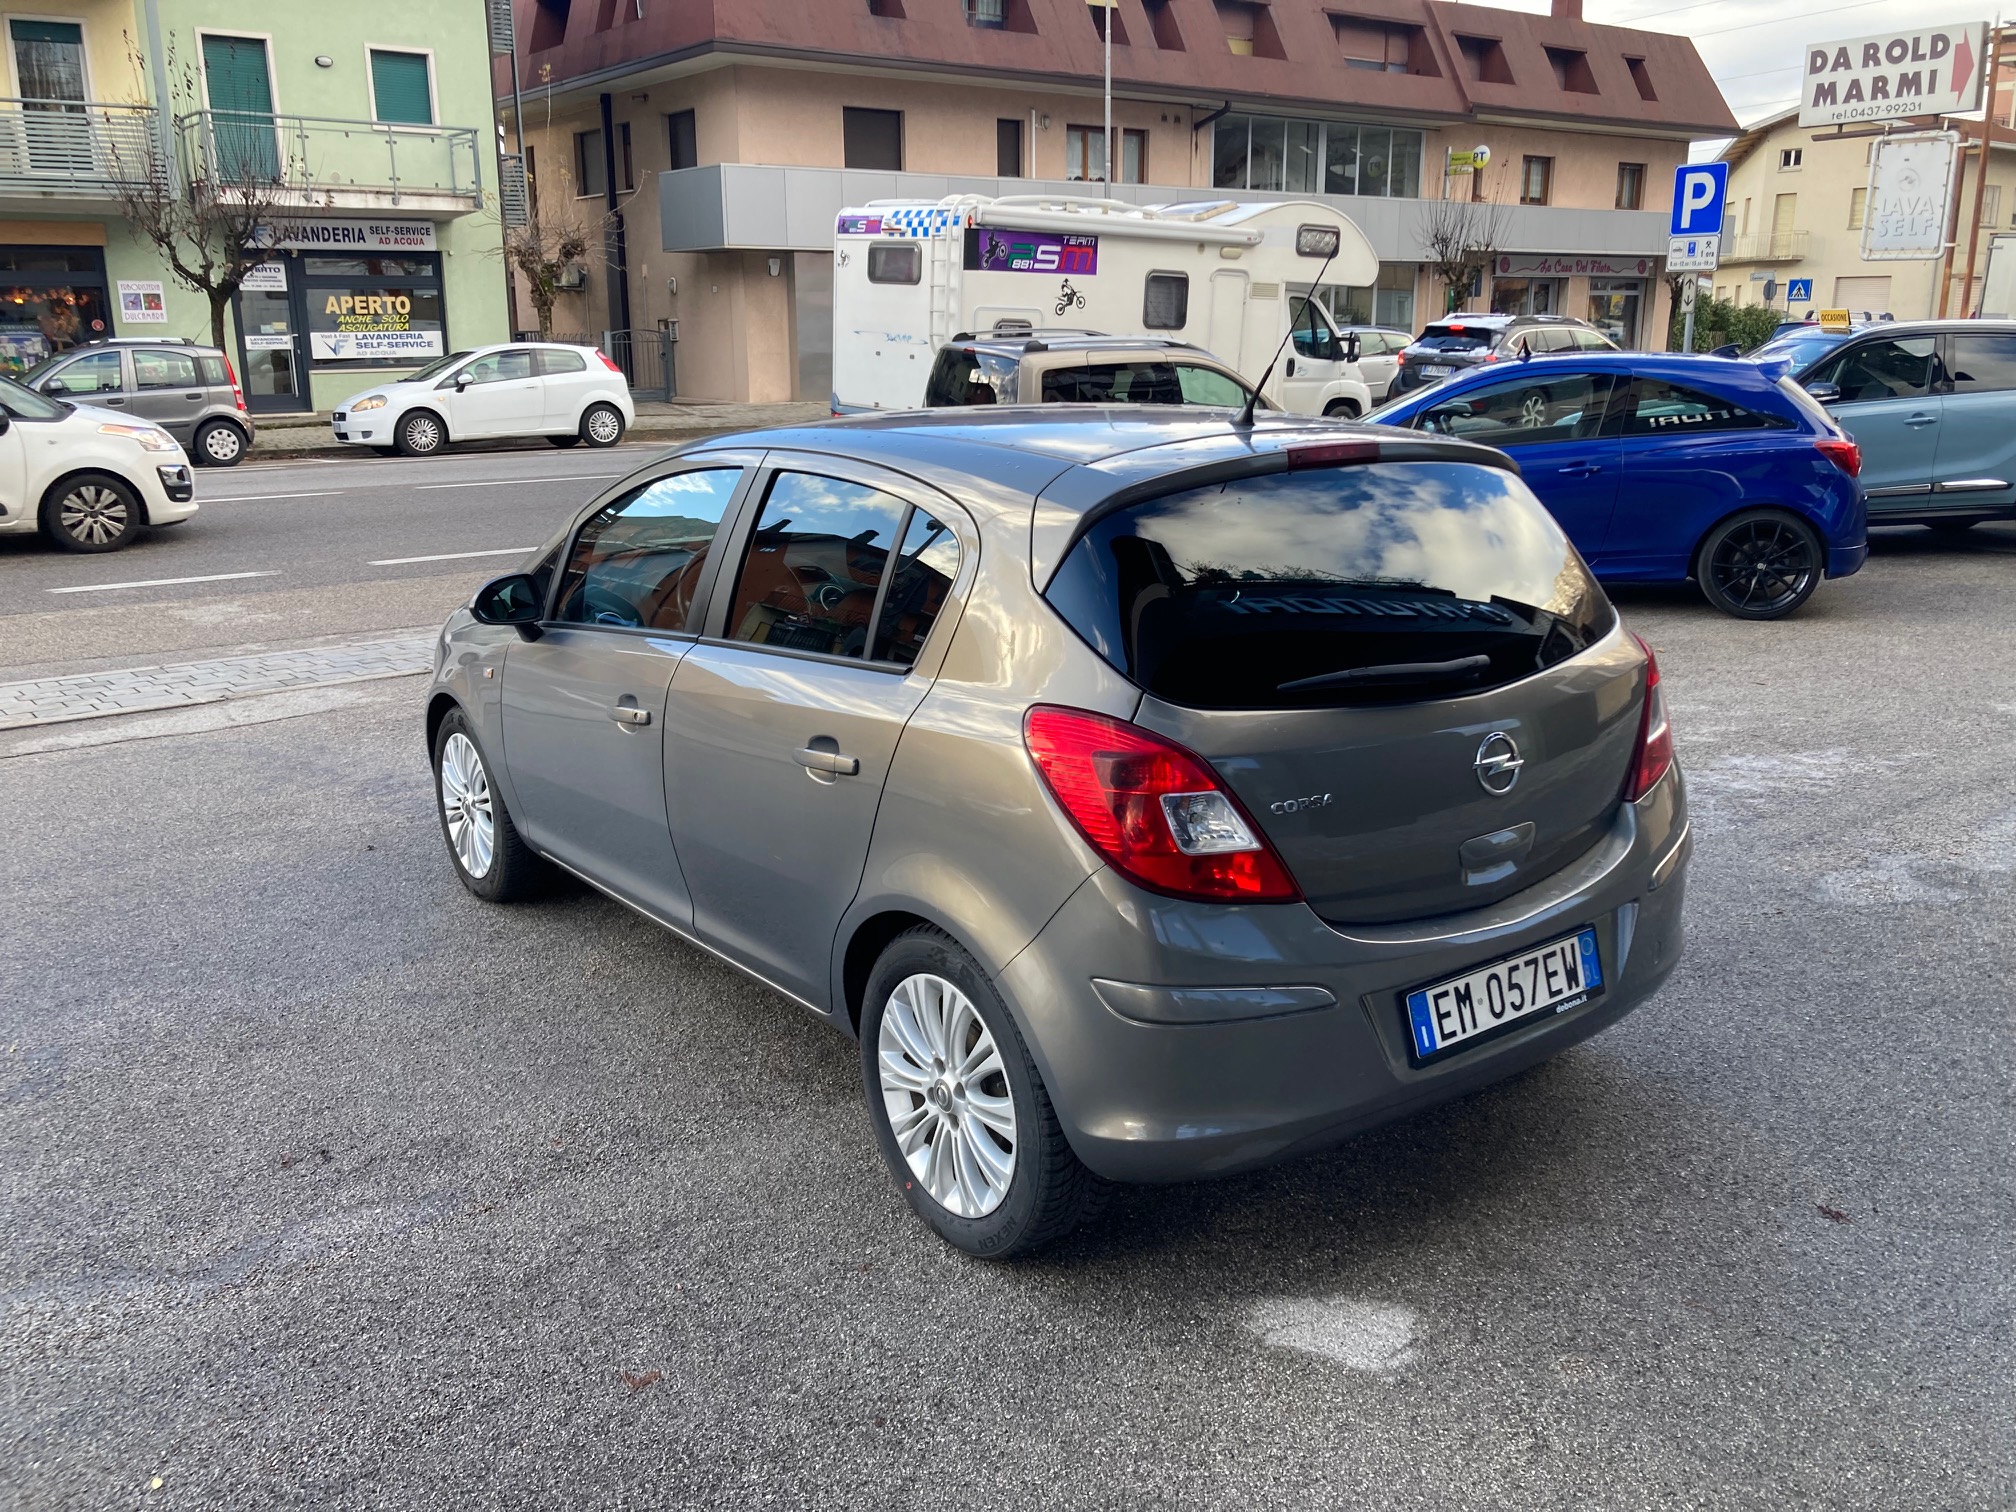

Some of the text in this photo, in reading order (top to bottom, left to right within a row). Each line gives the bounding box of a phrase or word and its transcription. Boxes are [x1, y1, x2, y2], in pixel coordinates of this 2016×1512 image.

[1861, 33, 1951, 69] ROLD
[1811, 68, 1939, 108] MARMI
[1680, 172, 1716, 229] P
[1879, 196, 1935, 217] LAVA
[369, 225, 431, 236] SELF-SERVICE
[1879, 217, 1934, 238] SELF
[378, 237, 425, 246] AD ACQUA
[1063, 235, 1095, 246] TEAM
[1011, 259, 1034, 270] 881
[1554, 258, 1573, 273] Casa
[1576, 259, 1589, 273] Del
[325, 295, 411, 315] APERTO
[337, 314, 409, 324] ANCHE SOLO
[1820, 313, 1848, 322] OCCASIONE
[338, 323, 410, 332] ASCIUGATURA
[356, 341, 434, 349] SELF-SERVICE
[1270, 793, 1332, 815] CORSA
[1432, 943, 1581, 1043] EM 057EW
[976, 1215, 1018, 1251] NEXEN
